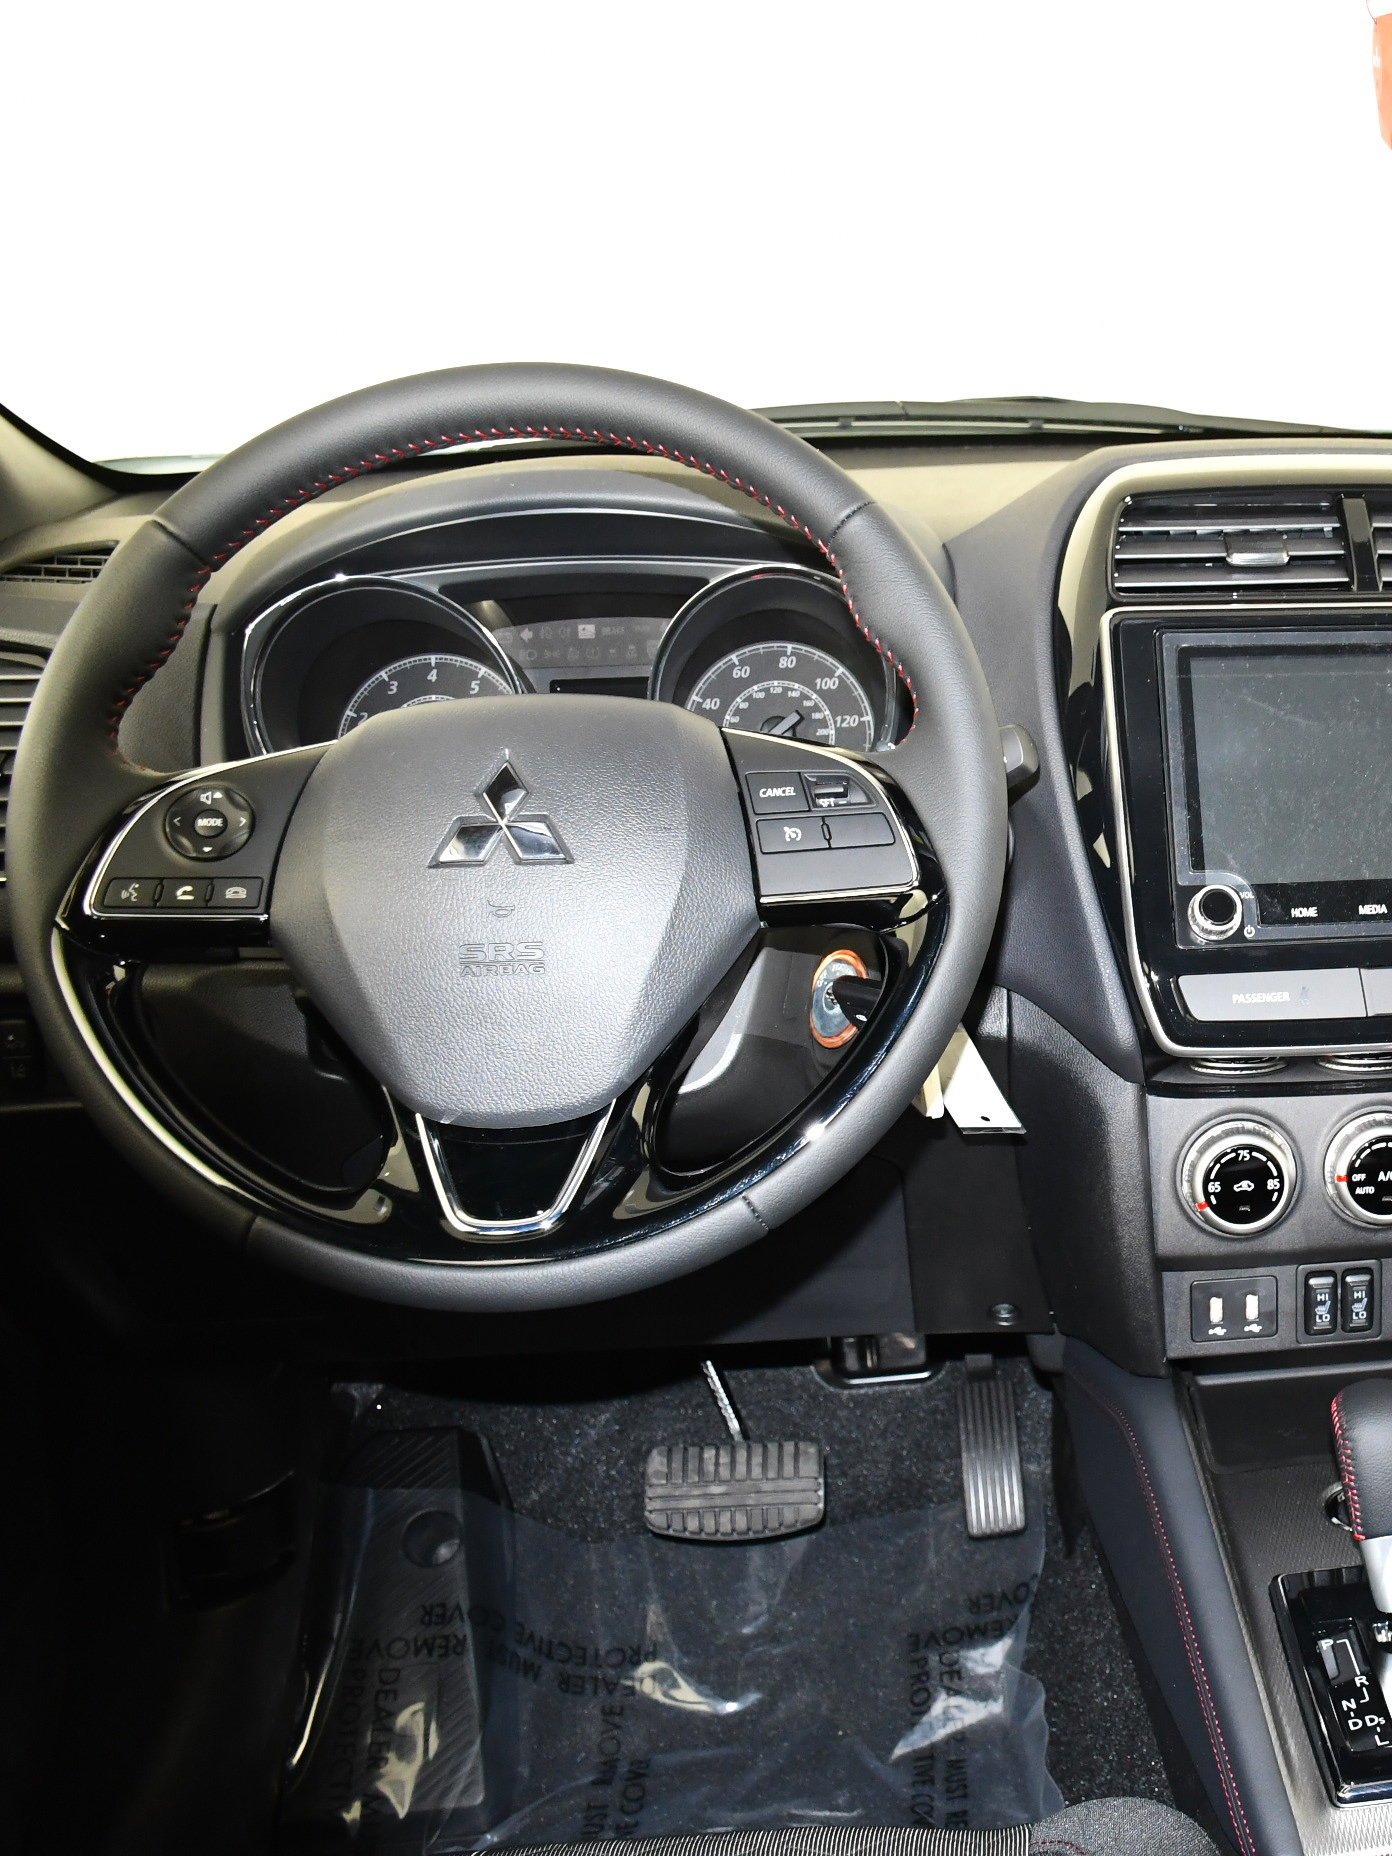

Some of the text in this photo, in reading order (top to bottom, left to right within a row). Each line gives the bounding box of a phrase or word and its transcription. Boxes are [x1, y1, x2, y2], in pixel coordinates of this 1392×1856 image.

[779, 655, 797, 668] 80
[427, 669, 438, 682] 4
[732, 666, 751, 678] 60
[387, 681, 398, 694] 3
[469, 680, 481, 694] 5
[815, 677, 839, 690] 100
[752, 691, 765, 699] 100
[769, 686, 783, 694] 120
[702, 697, 720, 710] 40
[835, 715, 859, 728] 120
[759, 786, 797, 798] CANCEL
[197, 818, 224, 827] MODE
[1239, 891, 1255, 899] VOL
[1290, 906, 1319, 918] HOME
[1358, 904, 1388, 915] MEDIA
[459, 941, 545, 961] SRS
[460, 962, 546, 978] AIRBAG
[1231, 991, 1290, 1004] PASSENGER
[1237, 1149, 1250, 1161] 75
[1352, 1173, 1366, 1182] OFF
[1207, 1181, 1221, 1193] 65
[1266, 1178, 1280, 1190] 85
[1355, 1186, 1375, 1195] AUTO
[1317, 1293, 1329, 1302] HI
[1354, 1290, 1366, 1299] HI
[1315, 1313, 1331, 1323] LO
[1352, 1311, 1367, 1320] LO
[1320, 1638, 1335, 1650] P
[1354, 1675, 1370, 1688] R
[1341, 1698, 1357, 1712] N
[1348, 1718, 1363, 1731] D
[1374, 1735, 1390, 1747] L
